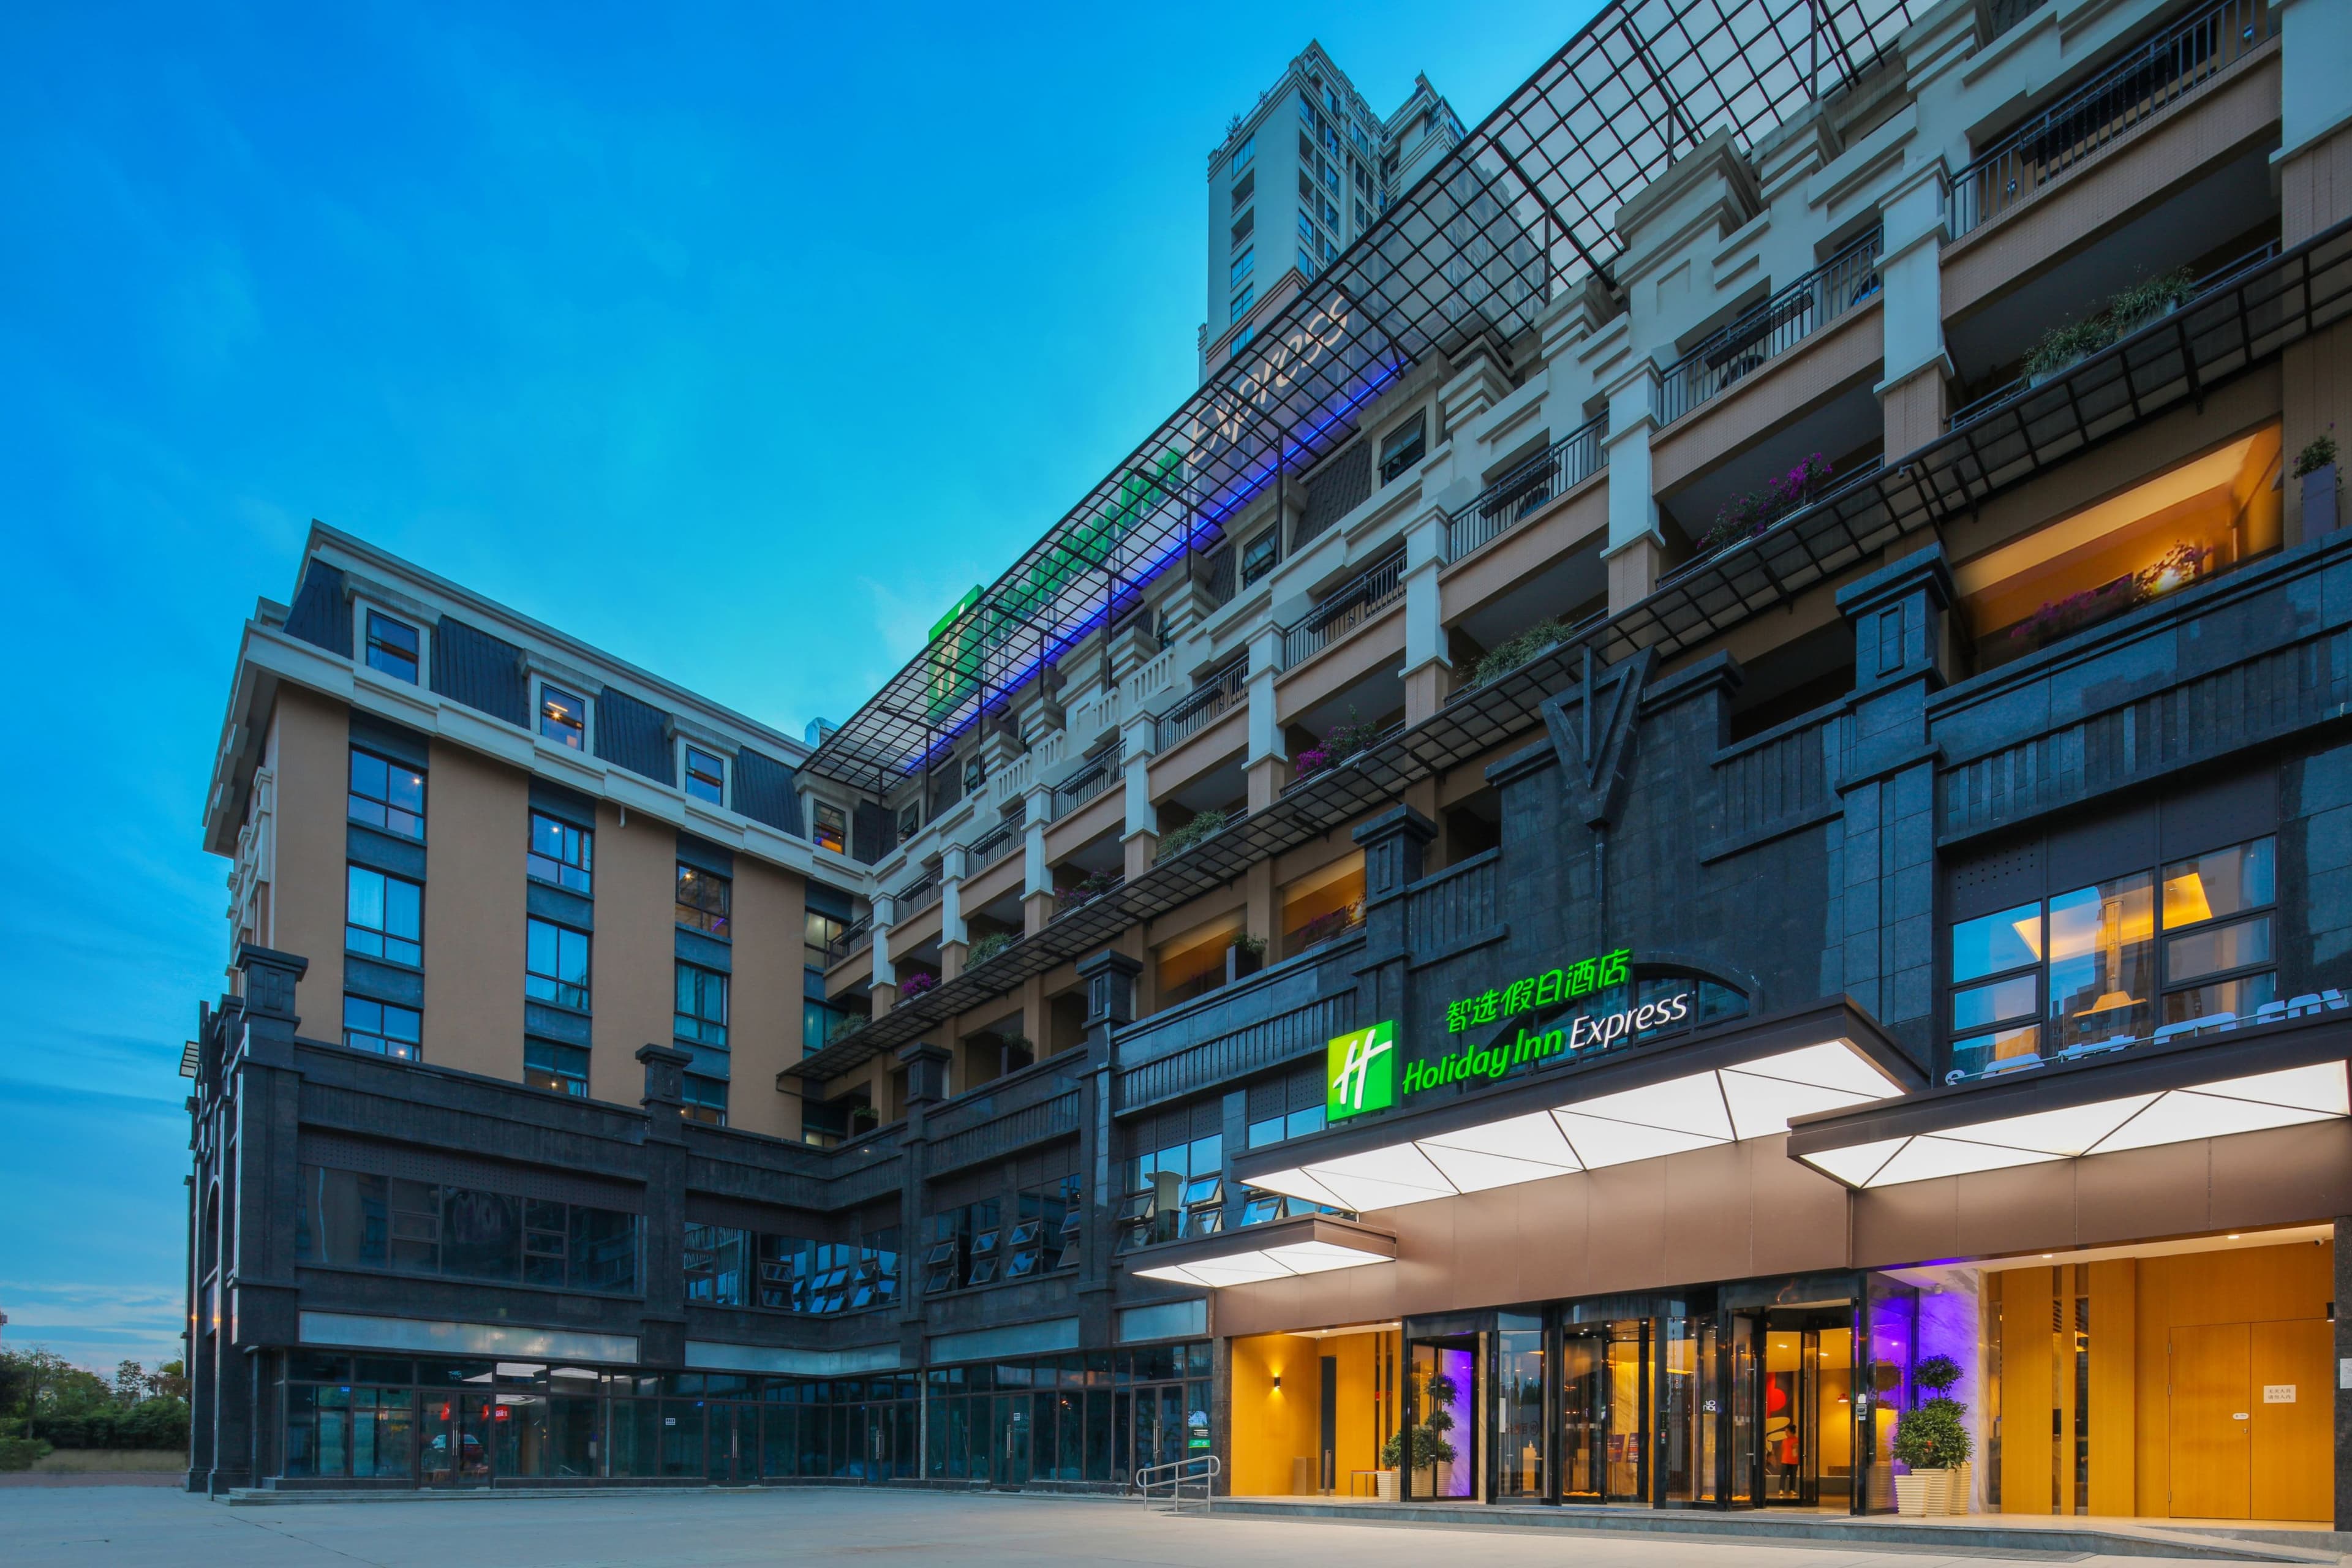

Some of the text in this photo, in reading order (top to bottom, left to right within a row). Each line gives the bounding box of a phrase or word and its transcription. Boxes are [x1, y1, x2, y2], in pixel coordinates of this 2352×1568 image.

[989, 293, 1348, 647] Holiday Inn Express
[1444, 948, 1634, 1034] 智选假日酒店
[1402, 993, 1689, 1095] Holiday Inn Express
